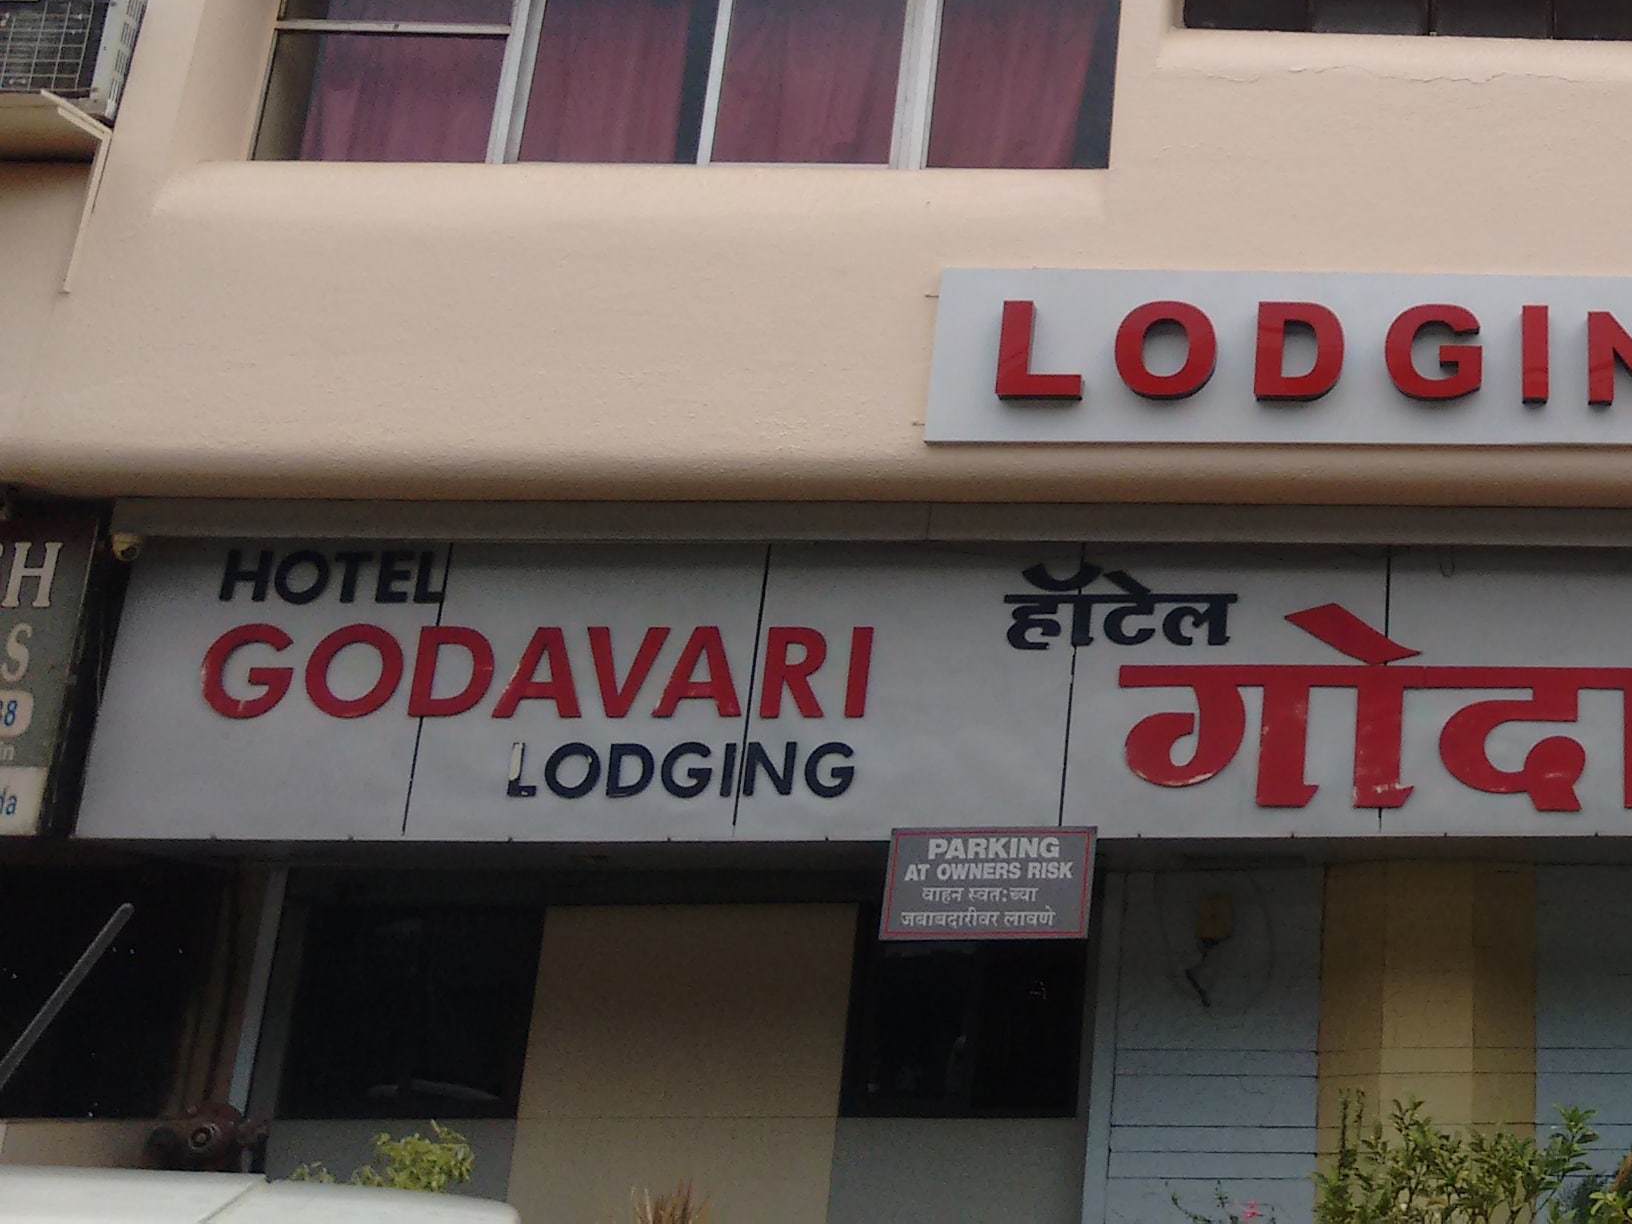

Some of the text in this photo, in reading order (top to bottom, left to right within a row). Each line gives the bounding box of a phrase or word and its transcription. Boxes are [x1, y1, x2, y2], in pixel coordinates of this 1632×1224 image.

[0, 541, 63, 608] H
[218, 550, 446, 605] HOTEL
[1004, 562, 1238, 650] हॉटेल
[201, 623, 873, 719] GODAVARI
[506, 742, 855, 799] LODGING
[904, 861, 1073, 881] AT OWNERS RISK
[927, 837, 1061, 860] PARKING
[922, 886, 964, 904] वाहन
[1004, 905, 1056, 926] लावणे
